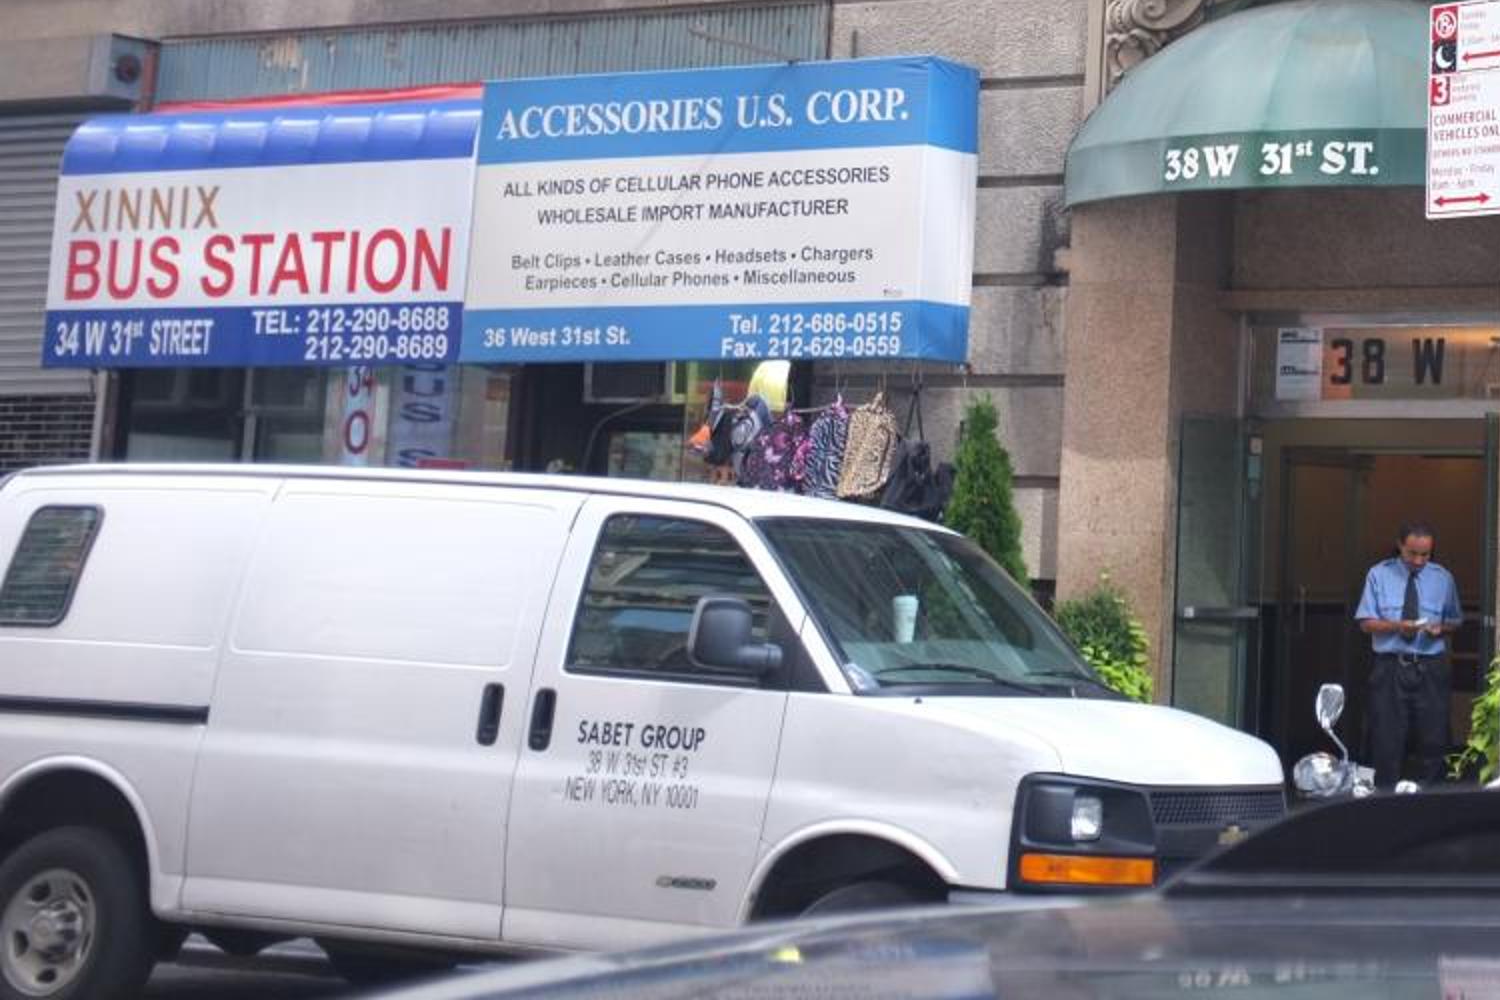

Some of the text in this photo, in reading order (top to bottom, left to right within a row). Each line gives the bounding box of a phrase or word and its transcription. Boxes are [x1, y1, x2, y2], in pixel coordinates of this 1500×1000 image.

[496, 88, 909, 141] ACCESSORIES U.S. CORP.
[1434, 109, 1497, 127] COMMERCIAL
[1433, 126, 1480, 141] VEHICLES
[1163, 140, 1379, 183] 38 W 31st ST.
[503, 165, 890, 198] ALL KINDS OF CELLULAR PHONE ACCESSORIES
[72, 185, 221, 233] XINNIX
[537, 198, 849, 226] WHOLESALE IMPORT MANUFACTURER
[64, 227, 452, 302] BUS STATION
[511, 244, 874, 273] Belt Clips Leather Cases Headsets Chargers
[525, 266, 856, 293] Earpieces Cellular Phones Miscellaneous
[253, 305, 450, 335] TEL: 212-290-8688
[729, 311, 902, 335] Tel. 212-686-0515
[54, 319, 215, 357] 34 W 31st STREET
[303, 334, 448, 361] 212-290-8689
[483, 324, 632, 348] 36 West 31st St.
[721, 335, 901, 359] Fax. 212-629-0559
[1330, 337, 1446, 386] 38 W
[577, 719, 706, 752] SABET GROUP
[603, 752, 620, 777] W
[565, 776, 699, 810] NEW YORK, NY 10001
